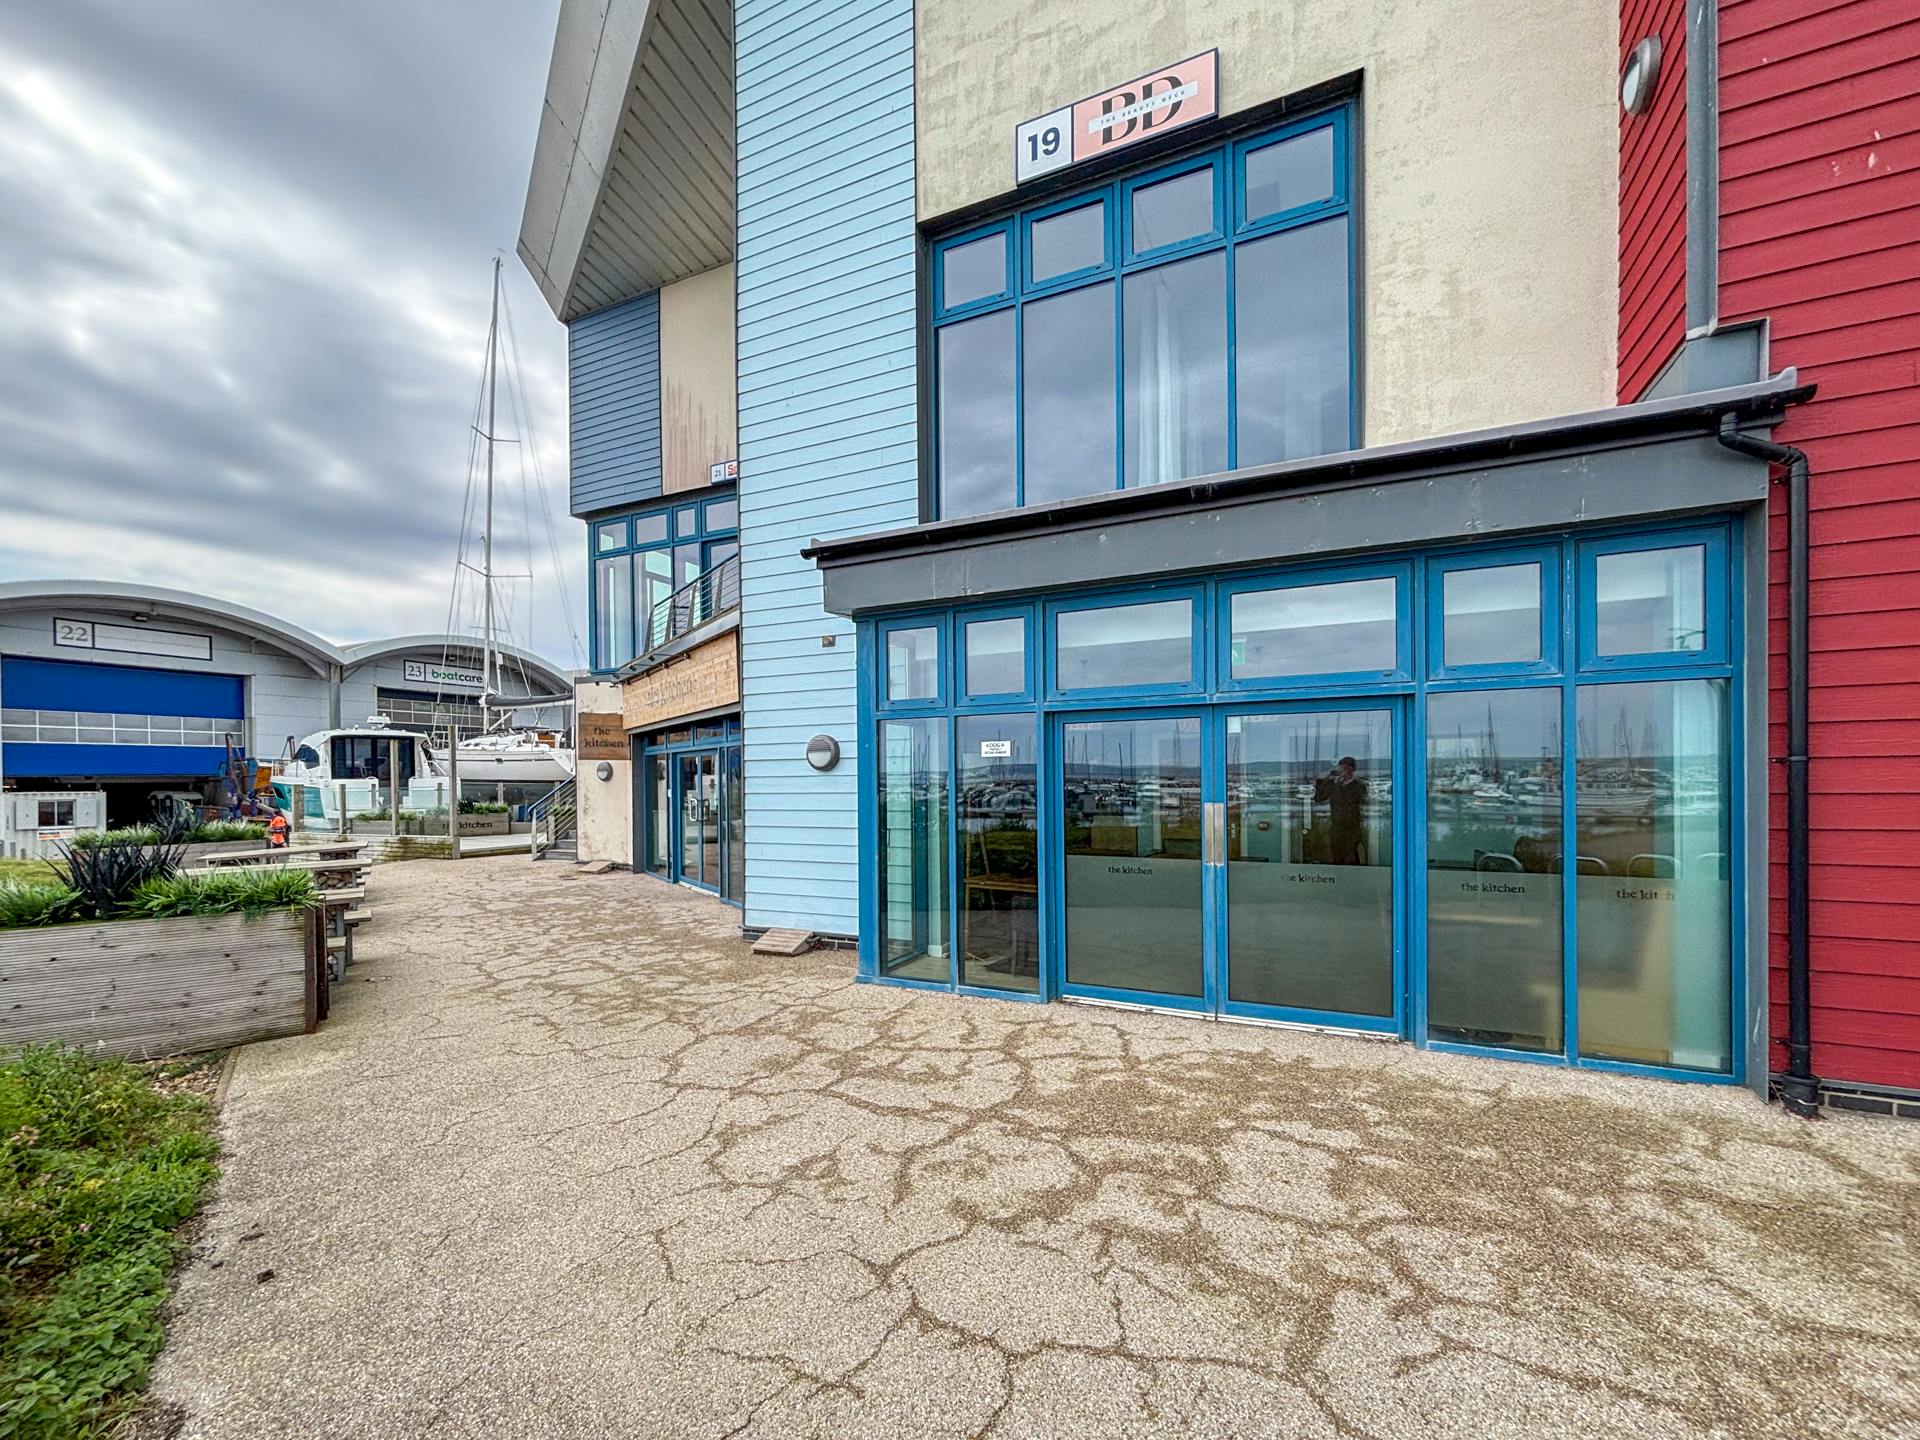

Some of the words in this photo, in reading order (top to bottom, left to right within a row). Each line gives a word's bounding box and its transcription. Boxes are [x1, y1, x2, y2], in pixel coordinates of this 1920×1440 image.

[1027, 127, 1061, 162] 19
[1102, 75, 1183, 146] BD
[60, 625, 88, 642] 22
[407, 665, 422, 678] 23
[431, 668, 483, 683] boatcare
[594, 726, 610, 736] the
[584, 736, 624, 748] kitchen
[459, 821, 493, 830] kitchen
[1108, 866, 1121, 874] the
[1122, 866, 1153, 875] kitchen
[1298, 874, 1335, 884] kitchen
[1461, 882, 1479, 892] the
[1481, 883, 1525, 893] kitchen
[1616, 888, 1637, 899] the
